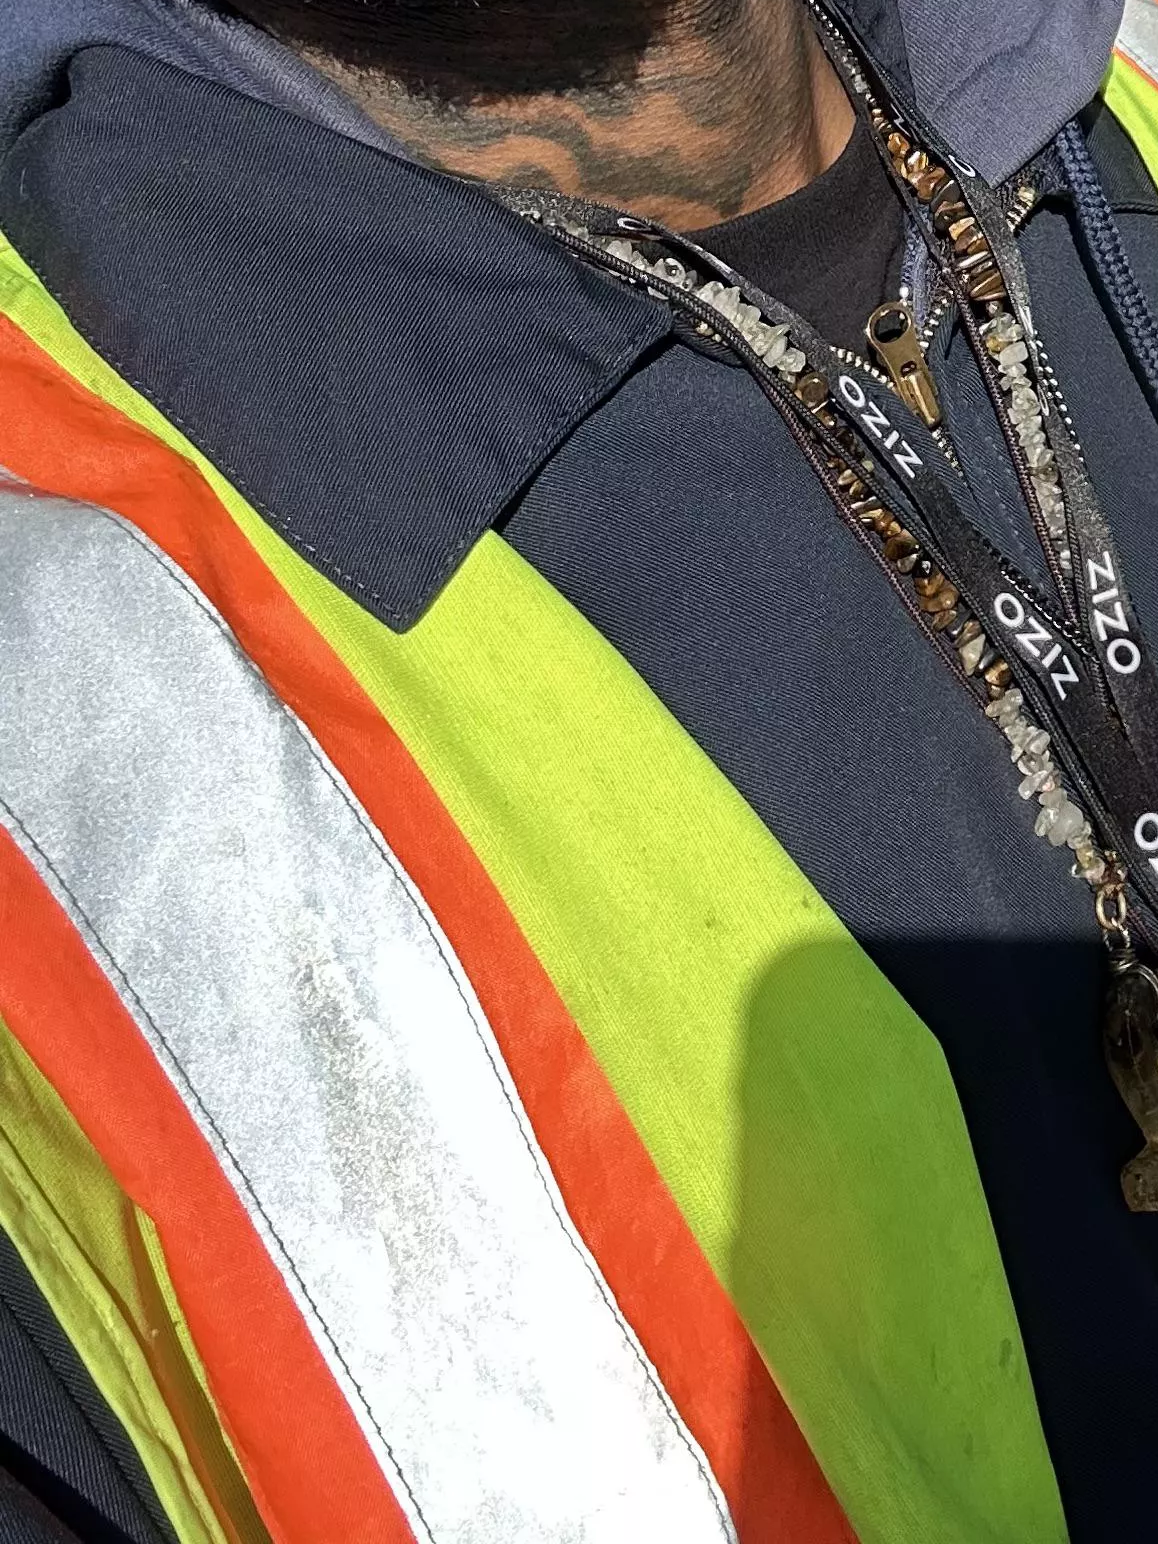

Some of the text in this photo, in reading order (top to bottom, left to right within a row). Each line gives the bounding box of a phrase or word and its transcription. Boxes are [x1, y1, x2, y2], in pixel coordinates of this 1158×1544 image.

[839, 375, 923, 478] ZIZO
[993, 592, 1079, 700] ZIZO
[1085, 551, 1141, 674] ZIZO
